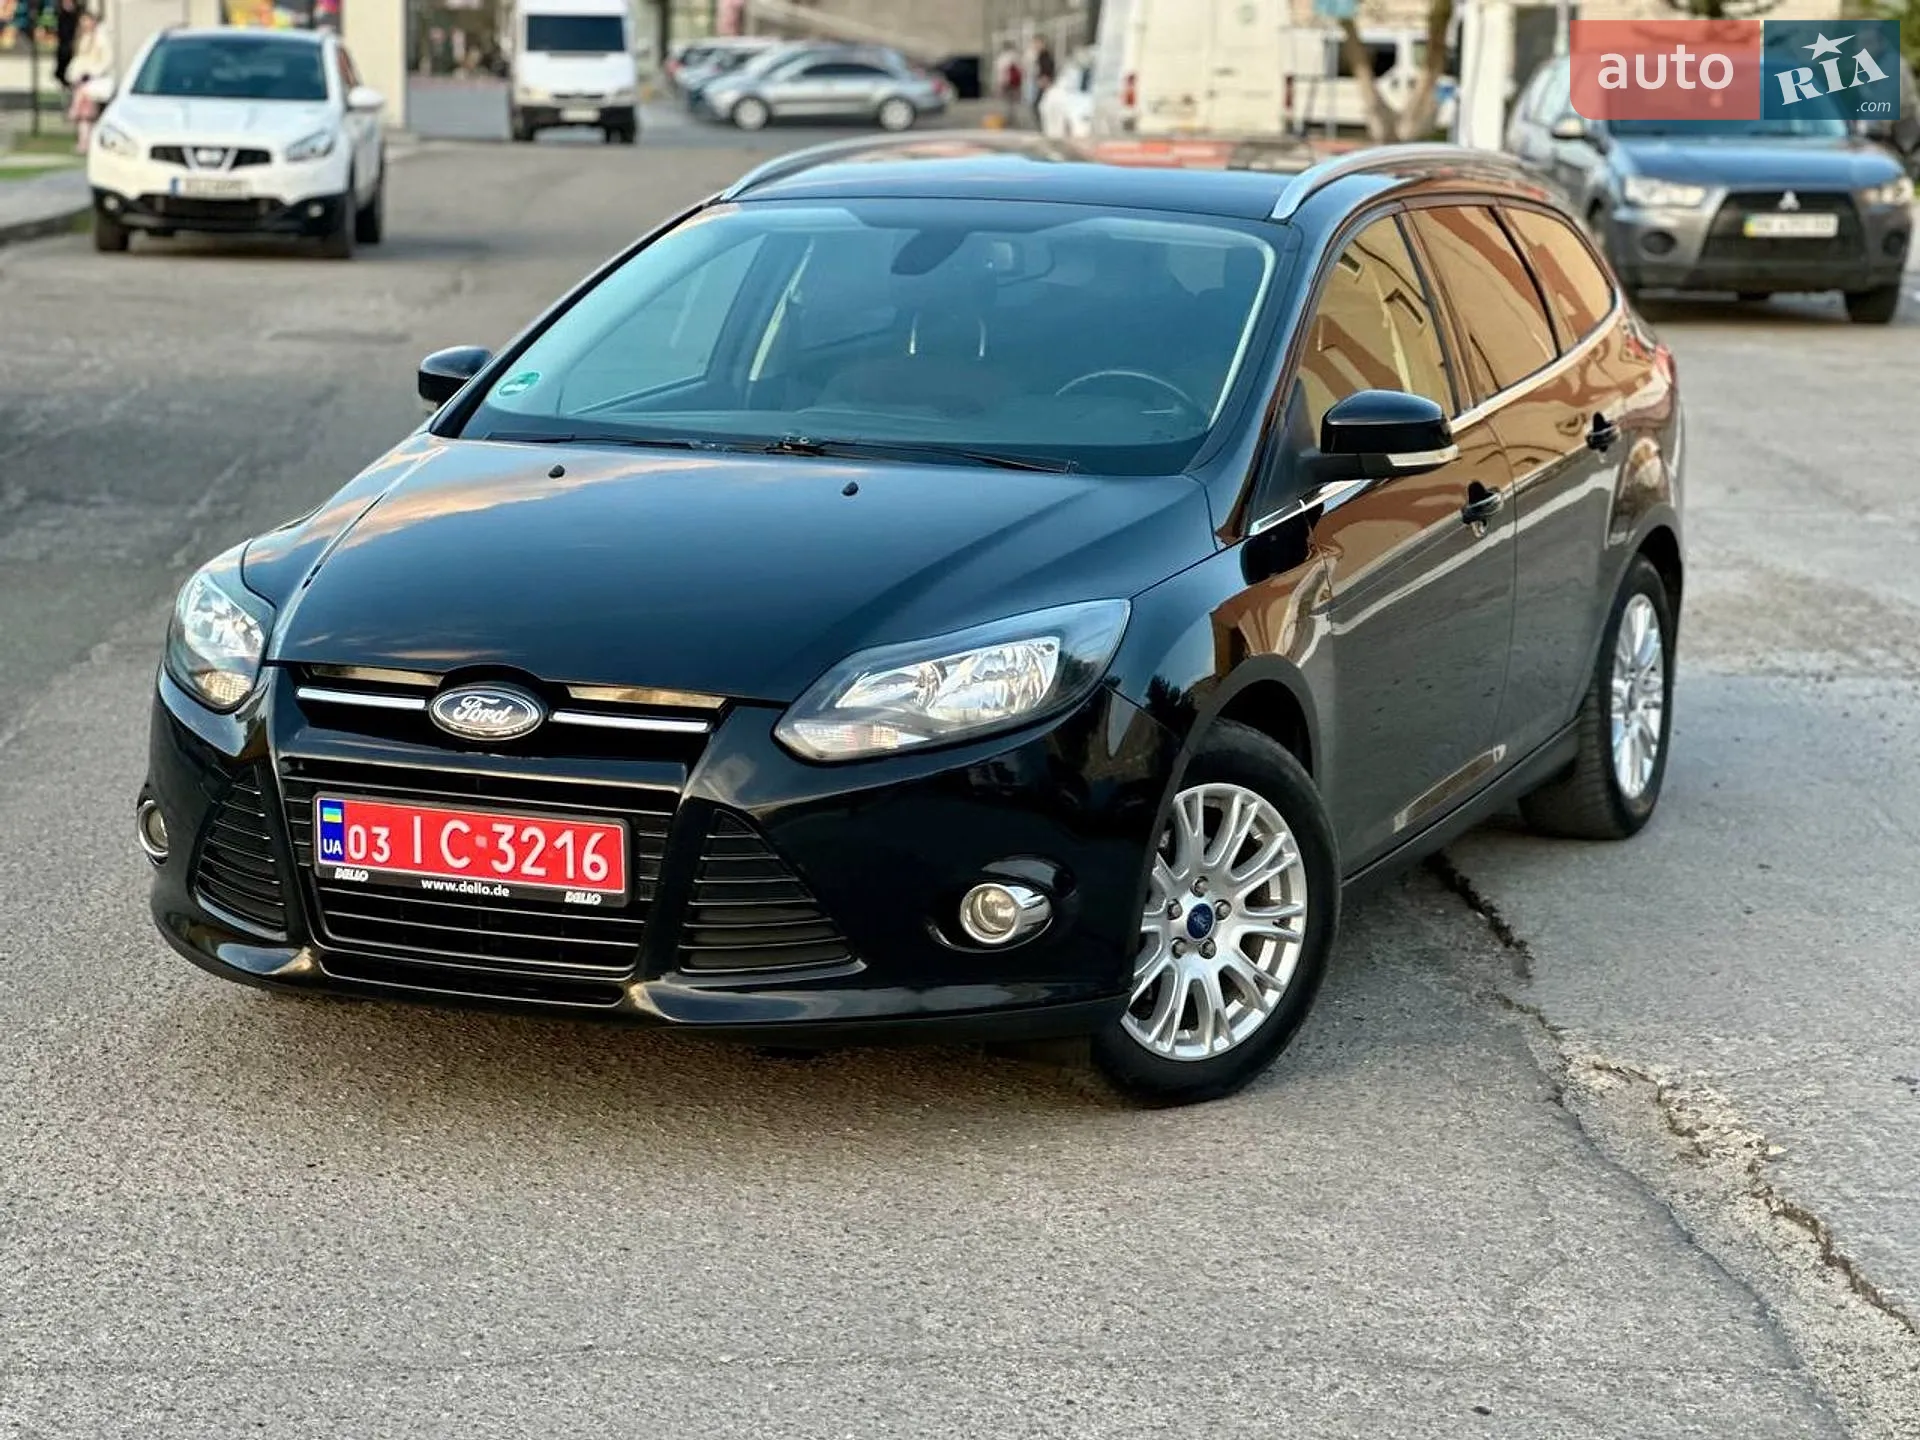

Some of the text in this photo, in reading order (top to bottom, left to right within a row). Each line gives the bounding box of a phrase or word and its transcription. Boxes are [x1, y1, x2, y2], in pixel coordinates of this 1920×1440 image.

[452, 695, 512, 725] Ford
[323, 838, 343, 856] UA
[347, 823, 391, 864] 03
[490, 822, 610, 883] 3216
[421, 877, 510, 897] www.dello.de
